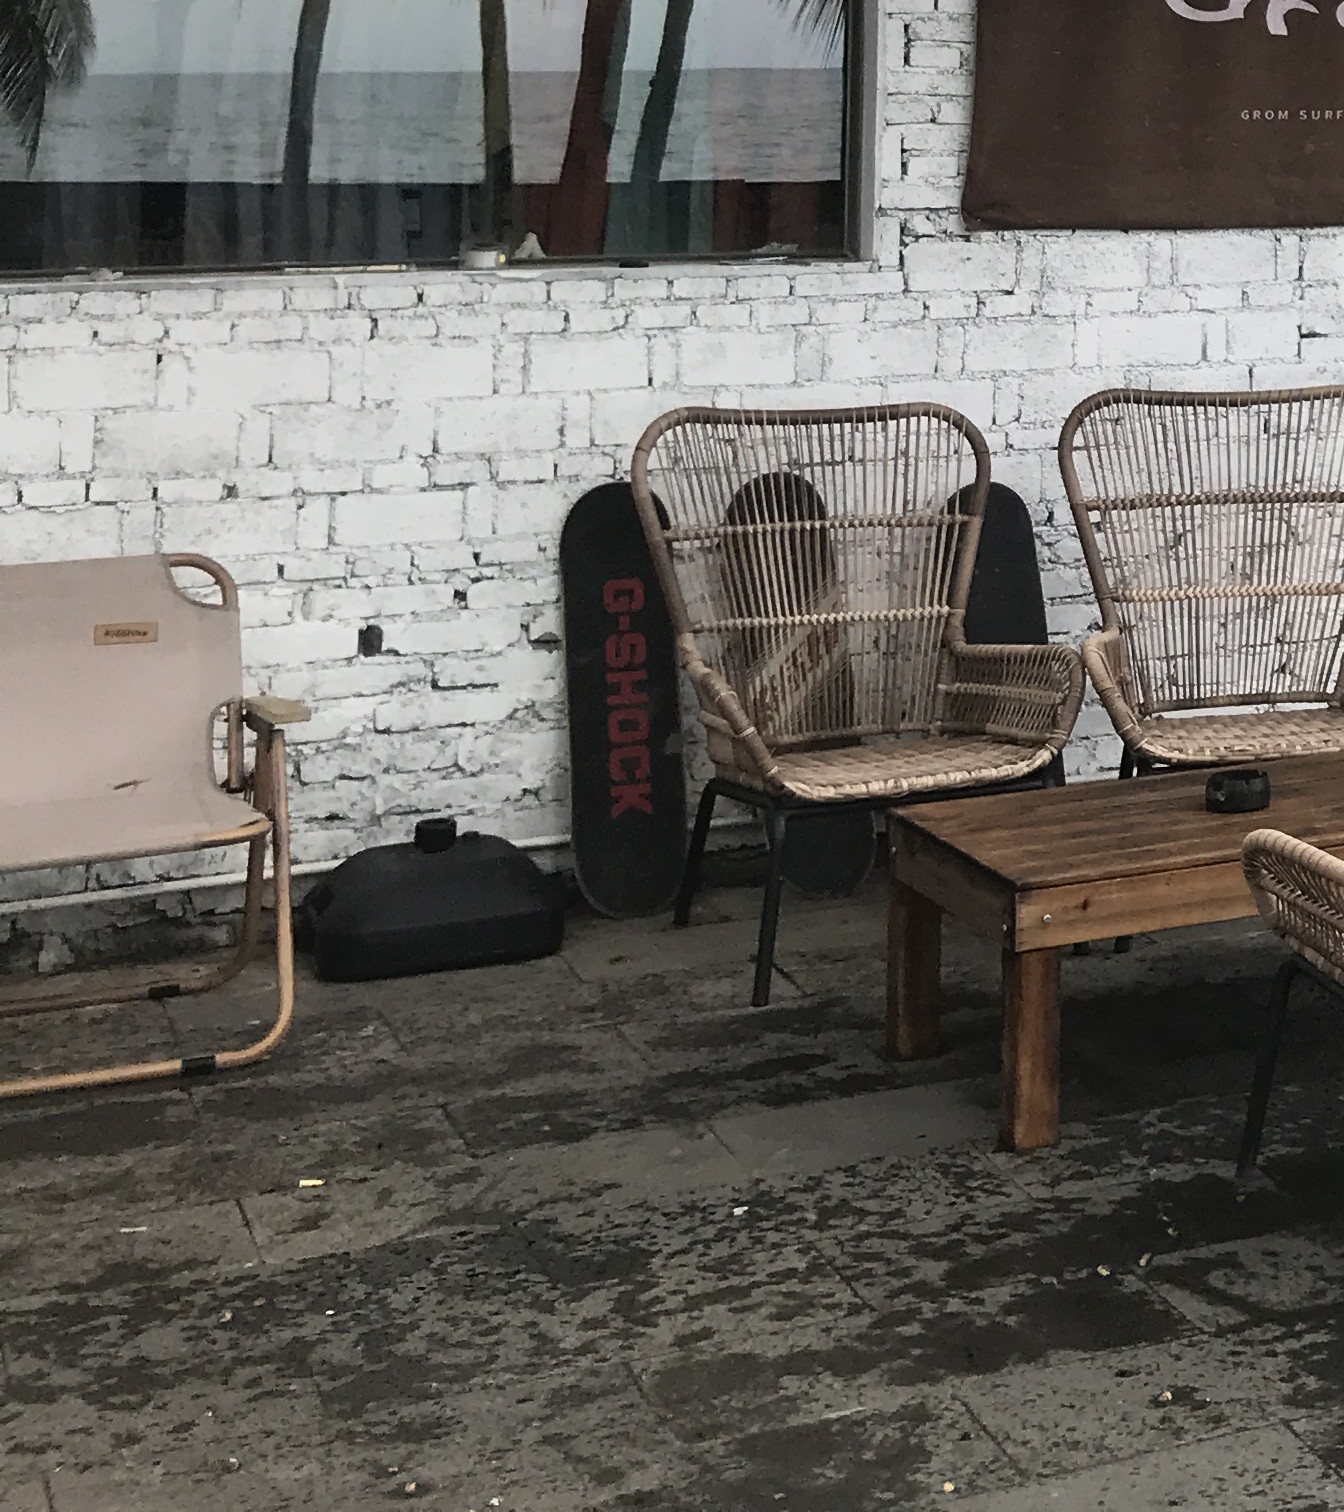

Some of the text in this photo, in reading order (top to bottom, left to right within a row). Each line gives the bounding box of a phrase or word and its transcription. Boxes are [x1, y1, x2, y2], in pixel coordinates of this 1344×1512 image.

[1240, 109, 1290, 121] GROM
[1298, 109, 1344, 121] SURF
[602, 577, 653, 820] G-SHOCK
